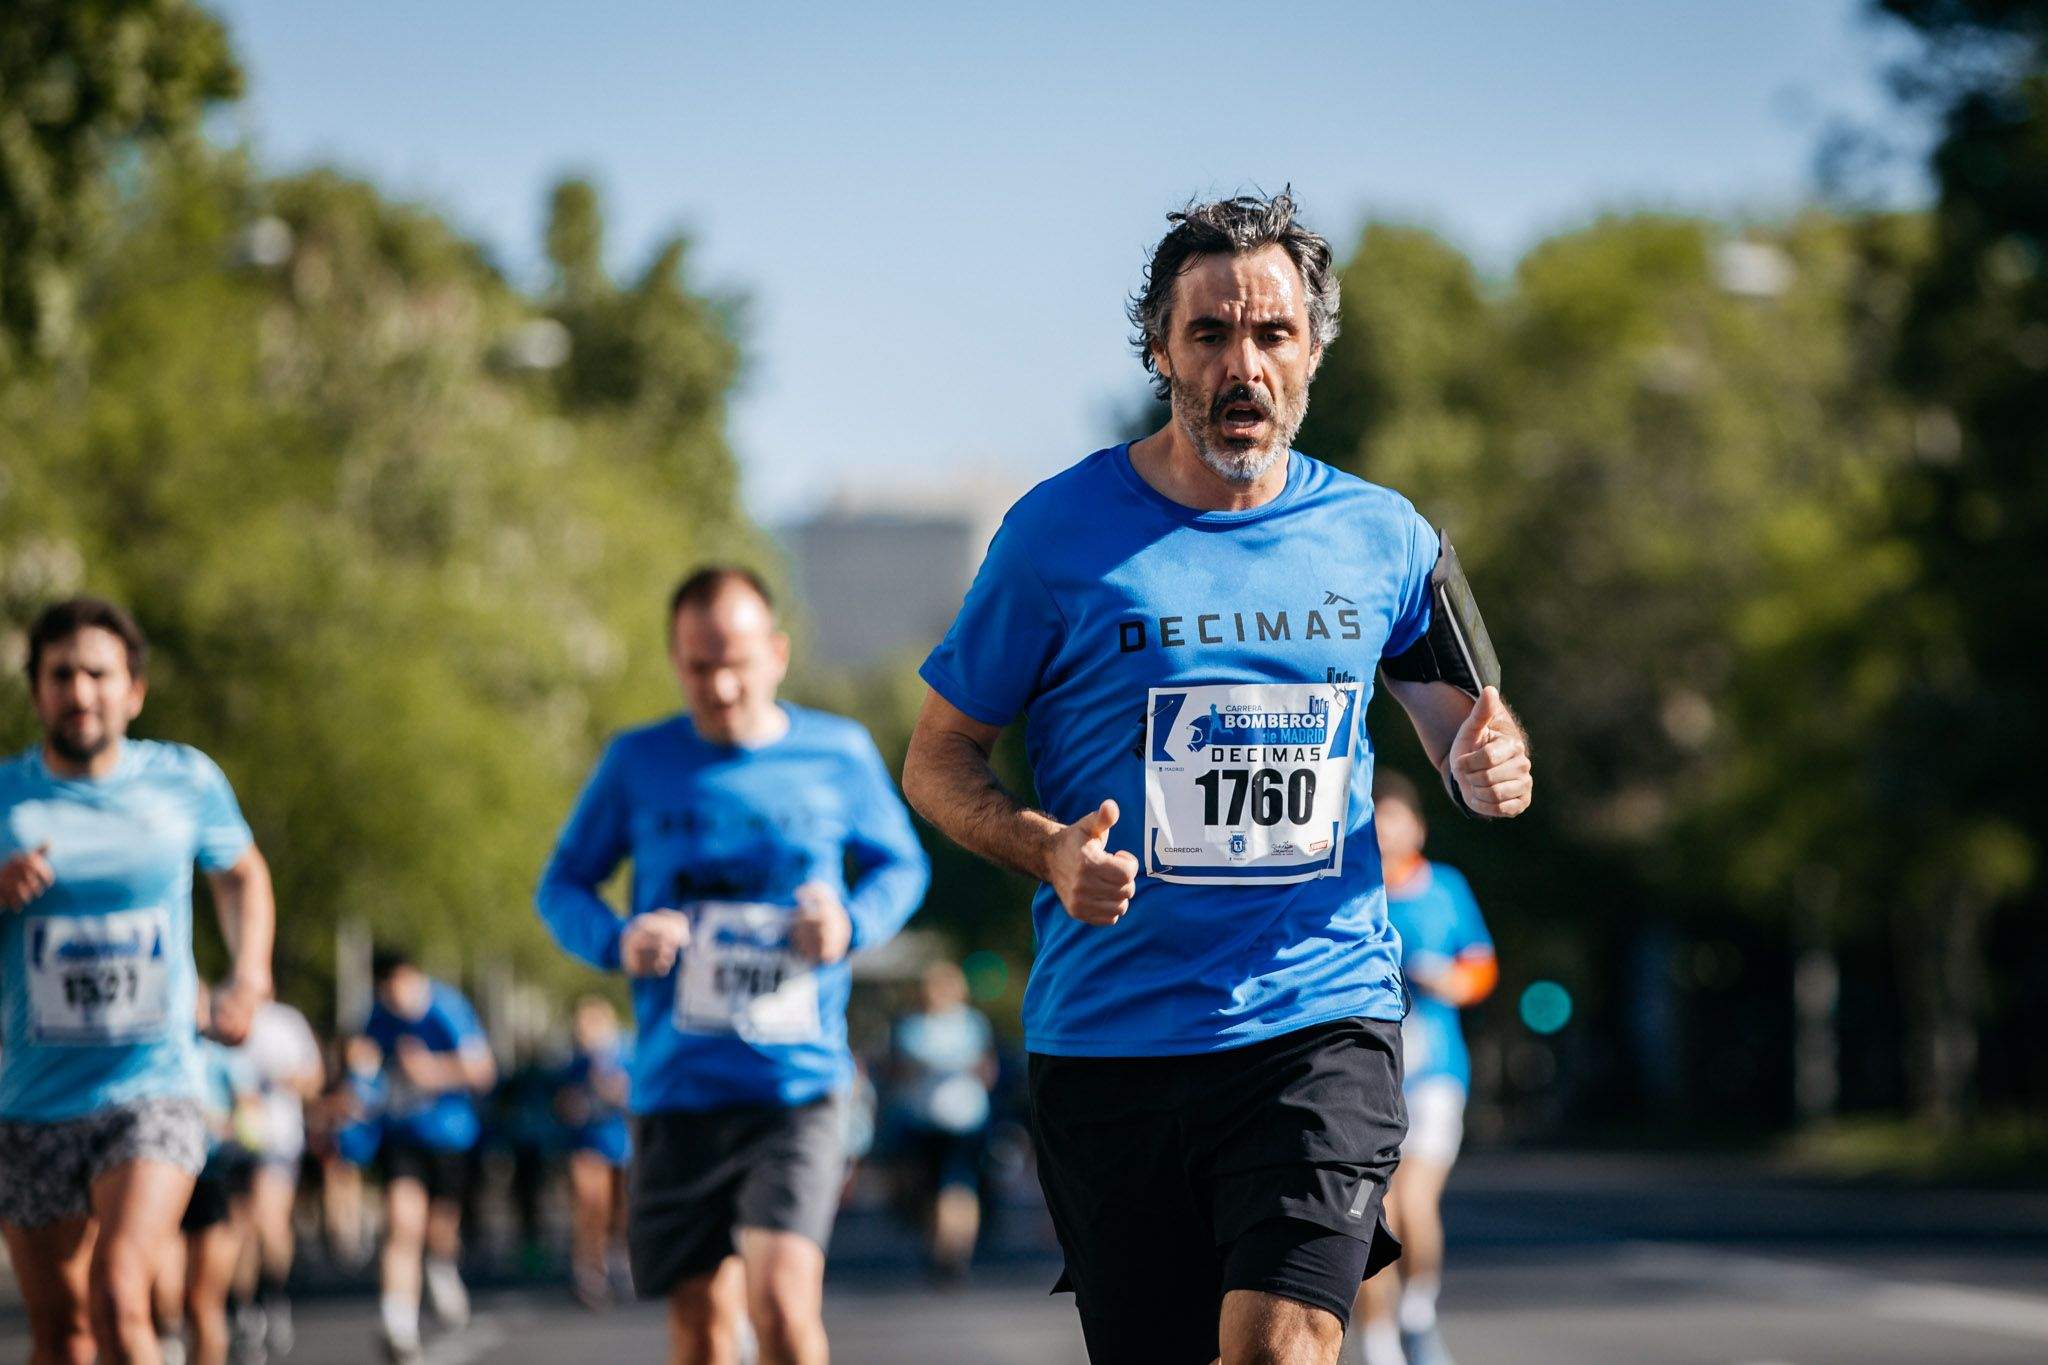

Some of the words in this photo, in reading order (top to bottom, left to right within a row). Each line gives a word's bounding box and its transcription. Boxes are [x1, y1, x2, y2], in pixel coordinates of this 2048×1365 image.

[1119, 609, 1361, 653] DECIMAS
[1225, 704, 1263, 713] CARRERA
[1224, 713, 1325, 729] BOMBEROS
[1262, 728, 1277, 744] de
[1280, 728, 1325, 744] MADRID
[1211, 746, 1321, 763] DECIMAS
[1195, 768, 1316, 826] 1760
